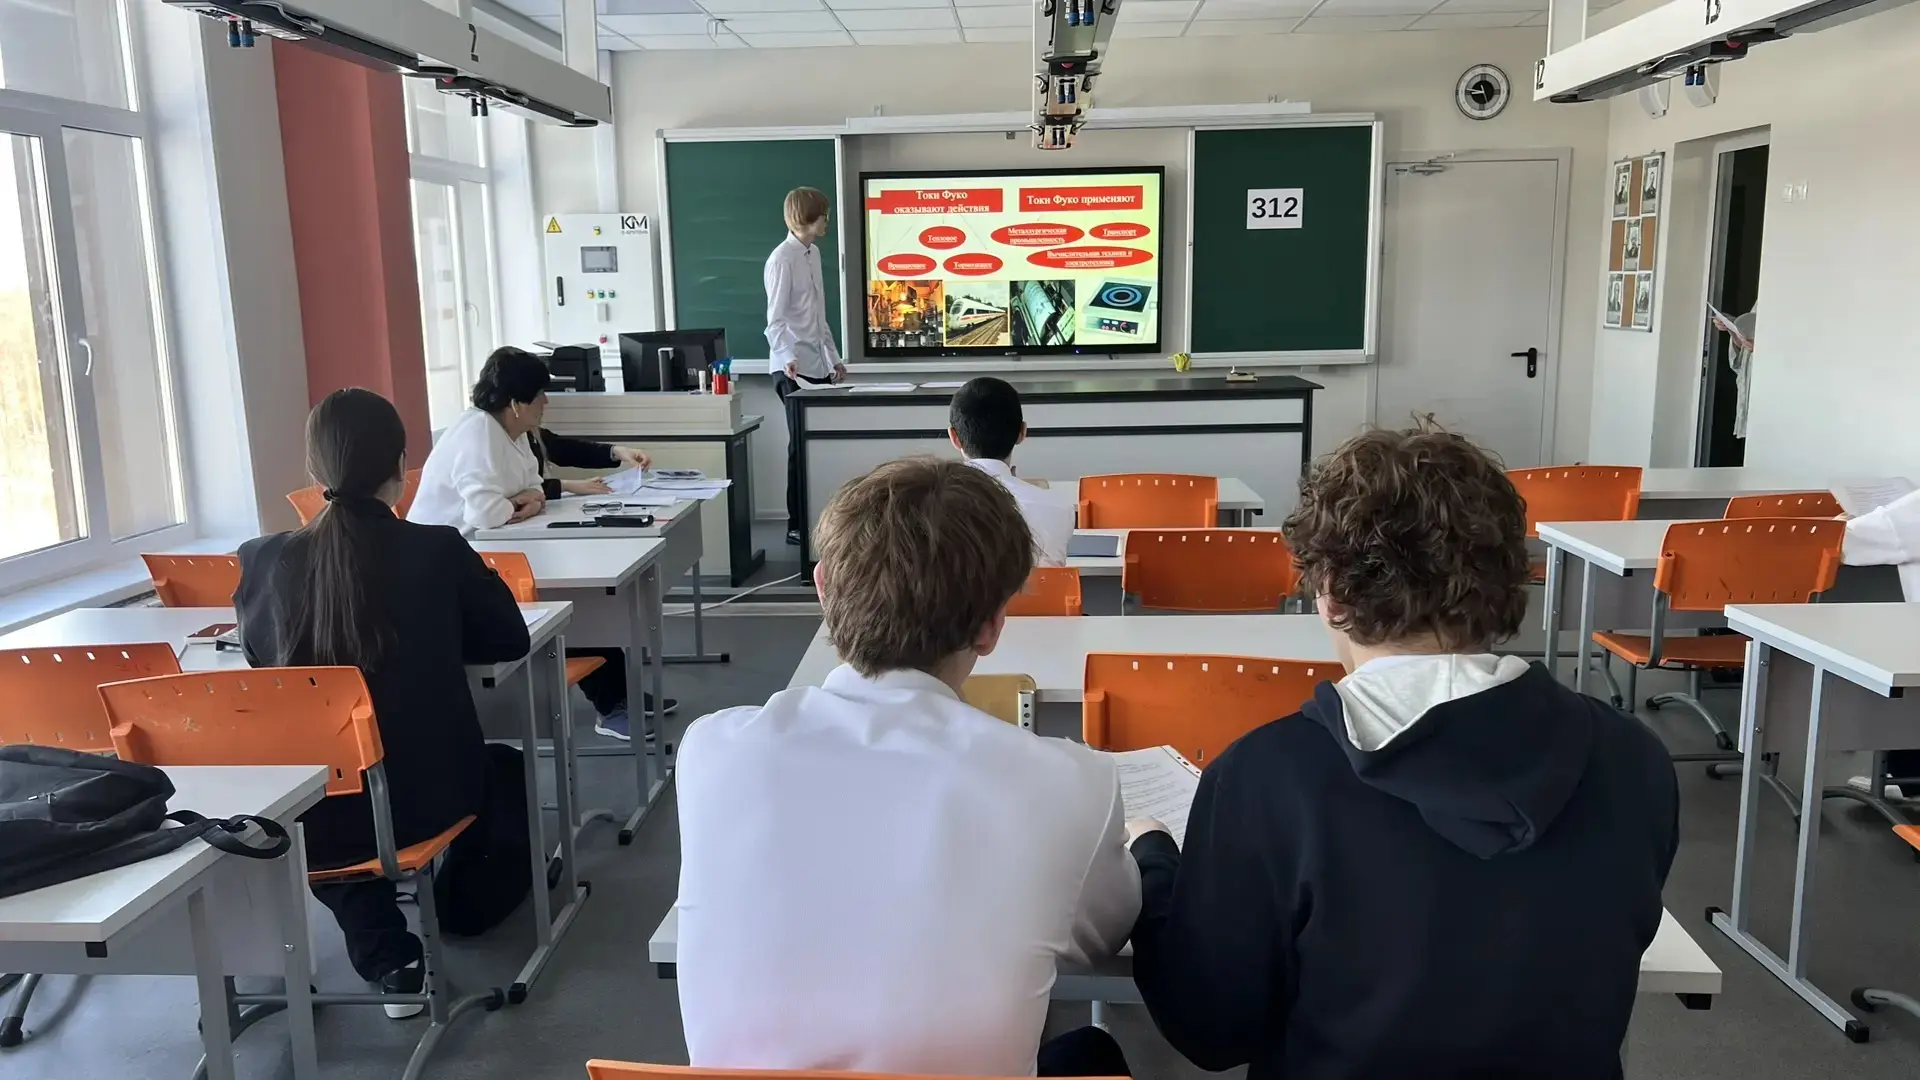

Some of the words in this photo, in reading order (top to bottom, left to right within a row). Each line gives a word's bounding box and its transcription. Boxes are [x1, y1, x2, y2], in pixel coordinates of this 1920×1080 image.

[468, 23, 479, 63] 2
[1536, 59, 1546, 90] 12
[916, 190, 939, 200] Токи
[942, 190, 968, 202] Фуко
[1027, 195, 1051, 205] Токи
[1053, 194, 1079, 206] Фуко
[1081, 194, 1136, 206] применяют
[894, 205, 945, 214] оказывают
[947, 204, 990, 214] действия
[1251, 196, 1298, 218] 312
[621, 215, 648, 230] KM
